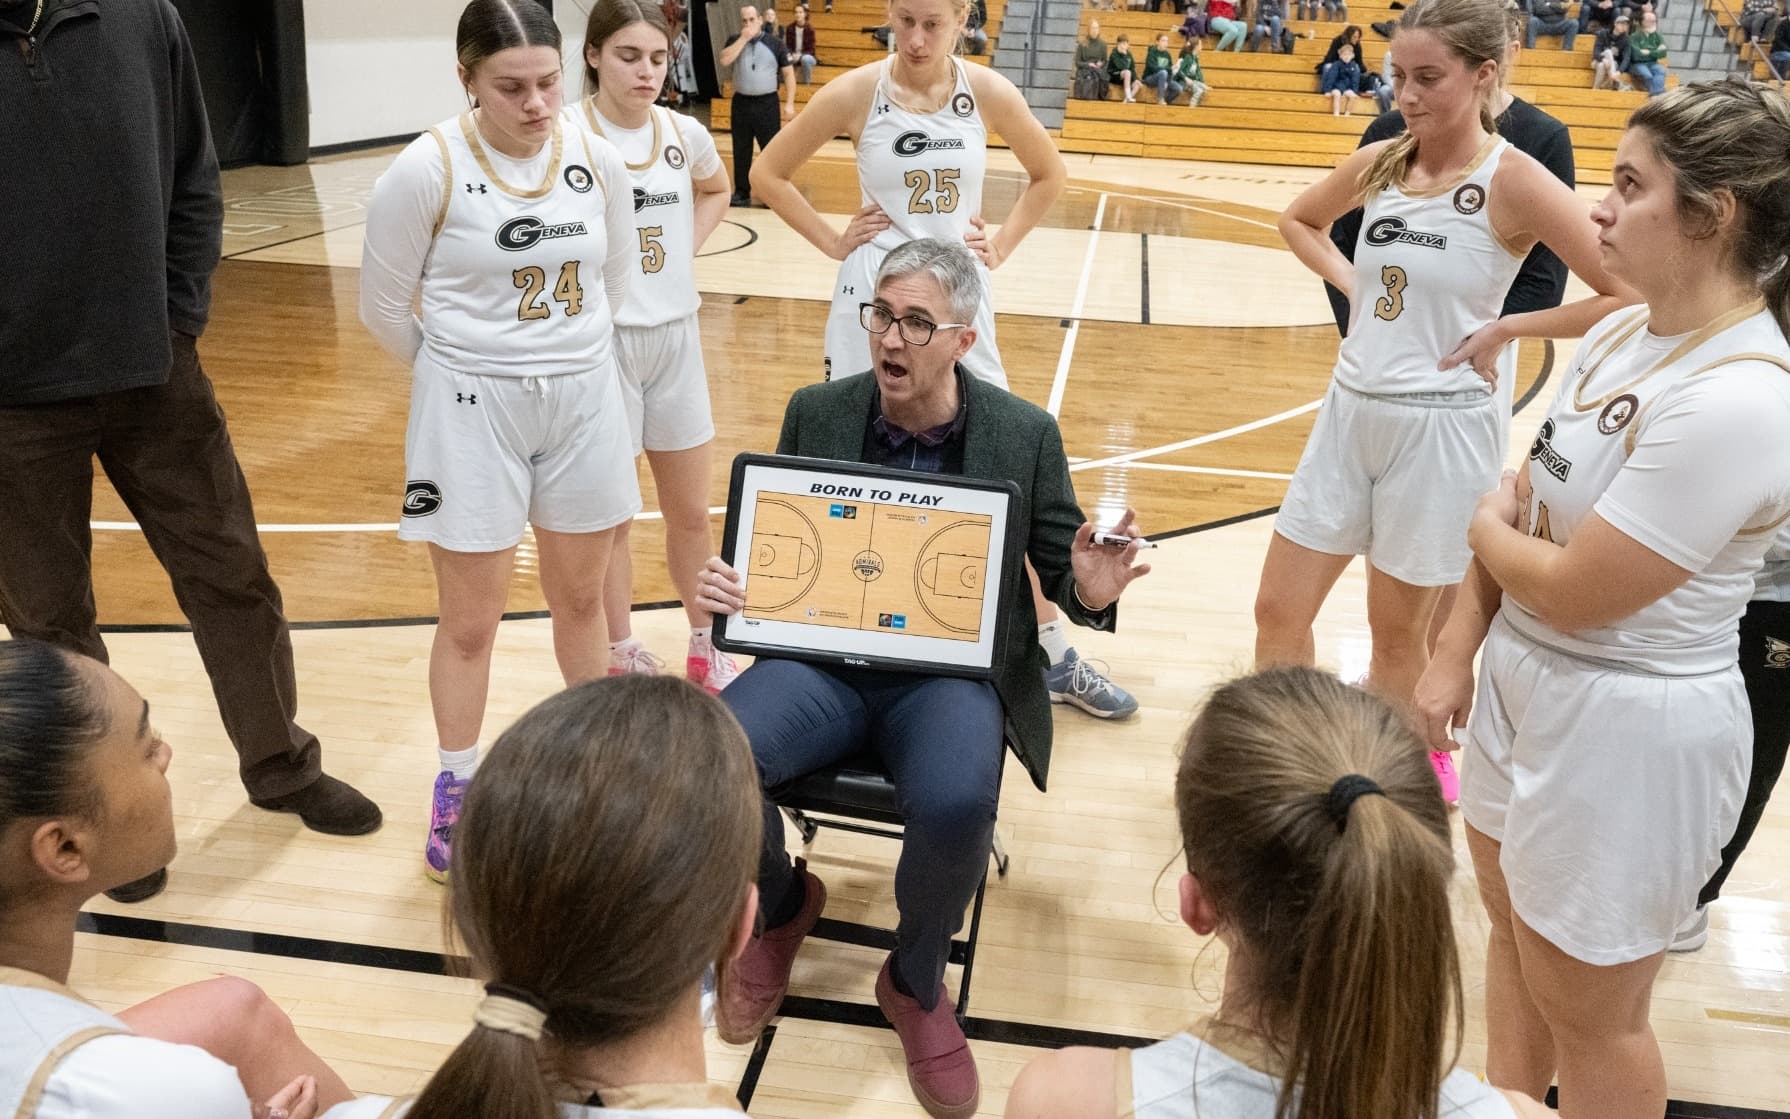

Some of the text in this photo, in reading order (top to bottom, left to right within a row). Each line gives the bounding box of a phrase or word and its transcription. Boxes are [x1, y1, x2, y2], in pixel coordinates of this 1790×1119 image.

[893, 130, 965, 157] GENEVA
[904, 168, 961, 214] 25
[495, 215, 588, 252] GENEVA
[636, 225, 666, 275] 5
[1364, 215, 1447, 250] GENEVA
[512, 260, 583, 321] 24
[1374, 264, 1408, 321] 3
[810, 483, 944, 507] BORN TO PLAY
